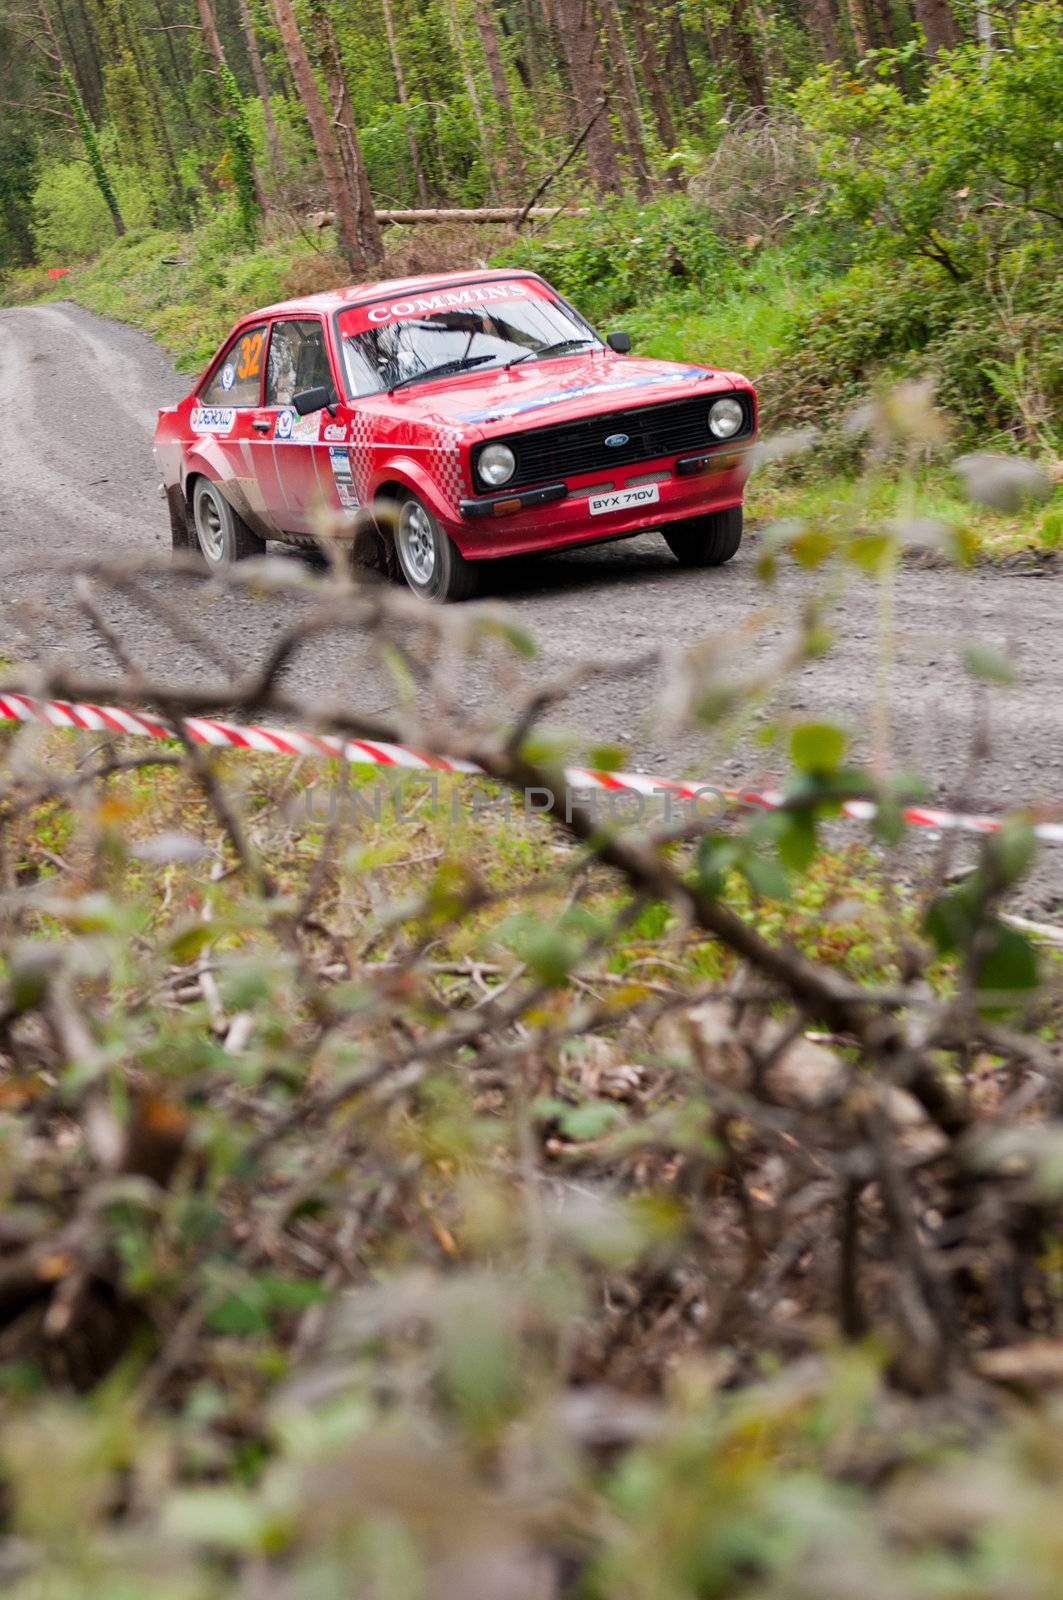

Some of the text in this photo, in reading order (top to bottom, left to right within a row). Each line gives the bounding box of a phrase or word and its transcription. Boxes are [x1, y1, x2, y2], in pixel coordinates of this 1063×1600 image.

[367, 284, 527, 322] COMMINS
[238, 333, 262, 379] 32
[593, 489, 654, 509] BYX 710V
